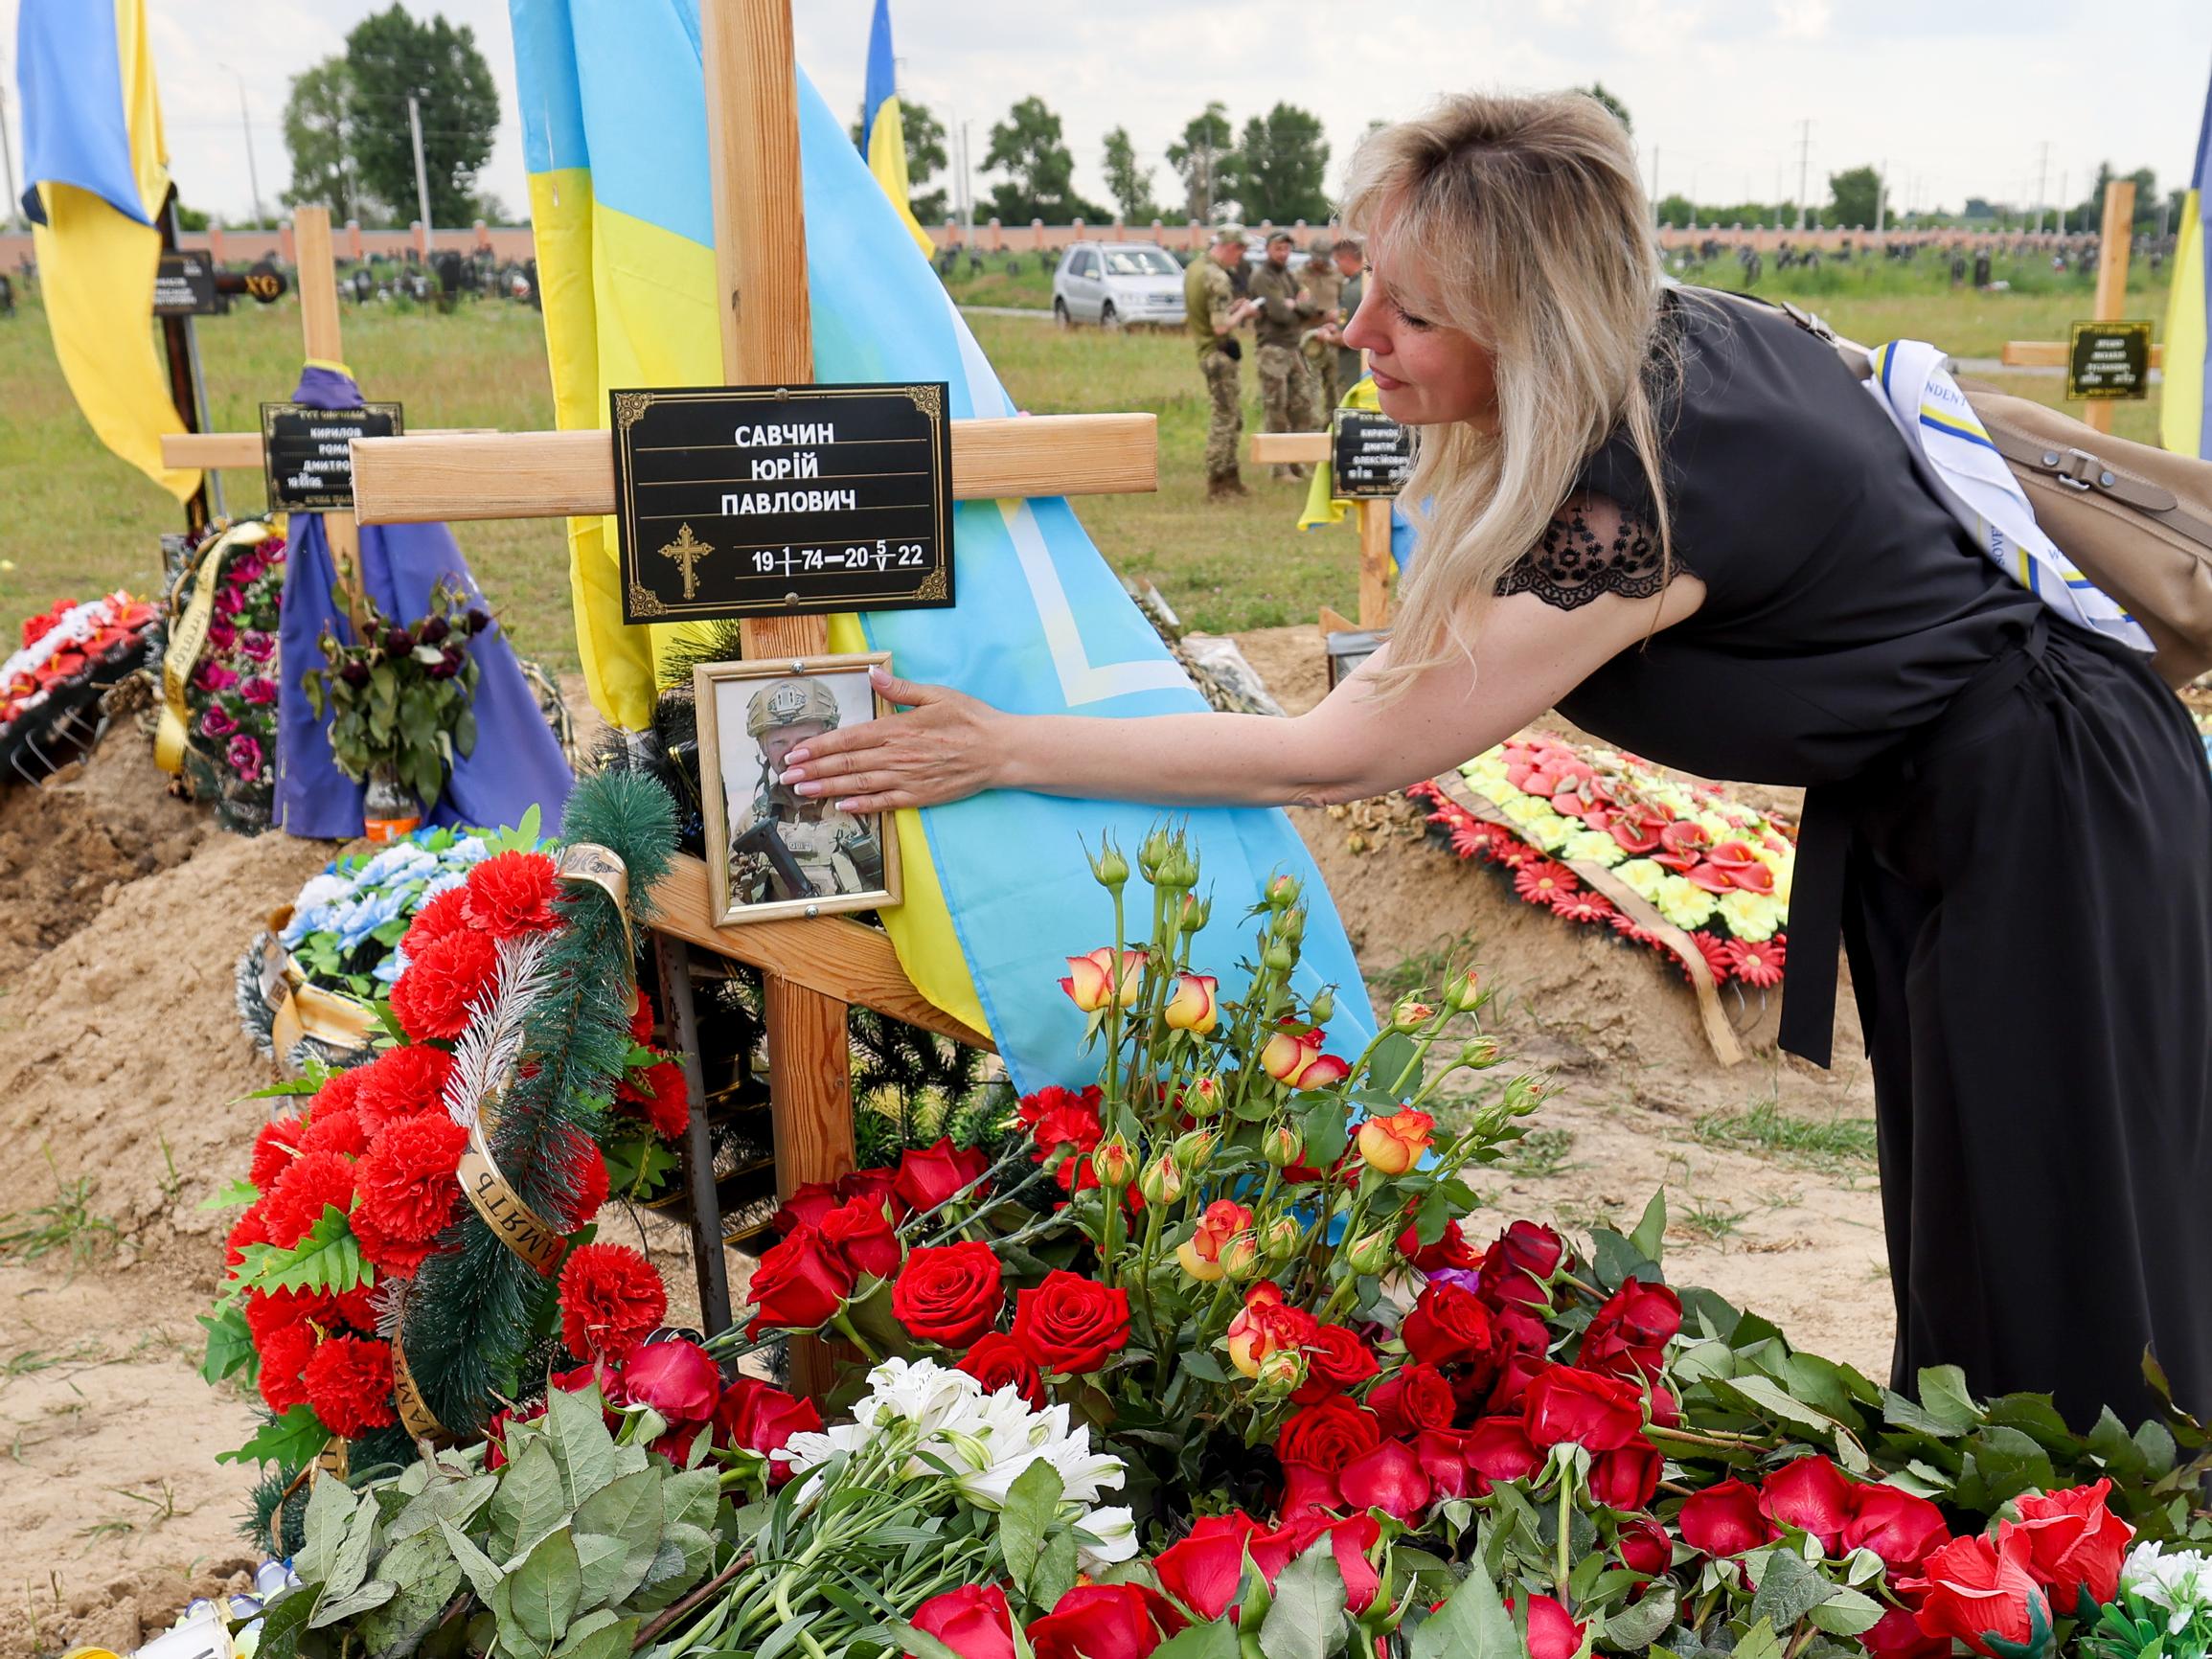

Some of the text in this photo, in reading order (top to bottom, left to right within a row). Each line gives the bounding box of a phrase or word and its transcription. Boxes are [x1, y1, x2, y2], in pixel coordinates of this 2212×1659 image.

[309, 427, 363, 440] КИРИЛОВ
[734, 422, 835, 448] САВЧИН
[318, 443, 350, 455] РОМА
[303, 460, 351, 472] ДМИТРО
[751, 452, 819, 481] ЮРІЙ
[720, 489, 856, 516] ПАВЛОВИЧ
[1992, 524, 2005, 565] SOVE
[476, 1171, 558, 1262] АМЯТЬ
